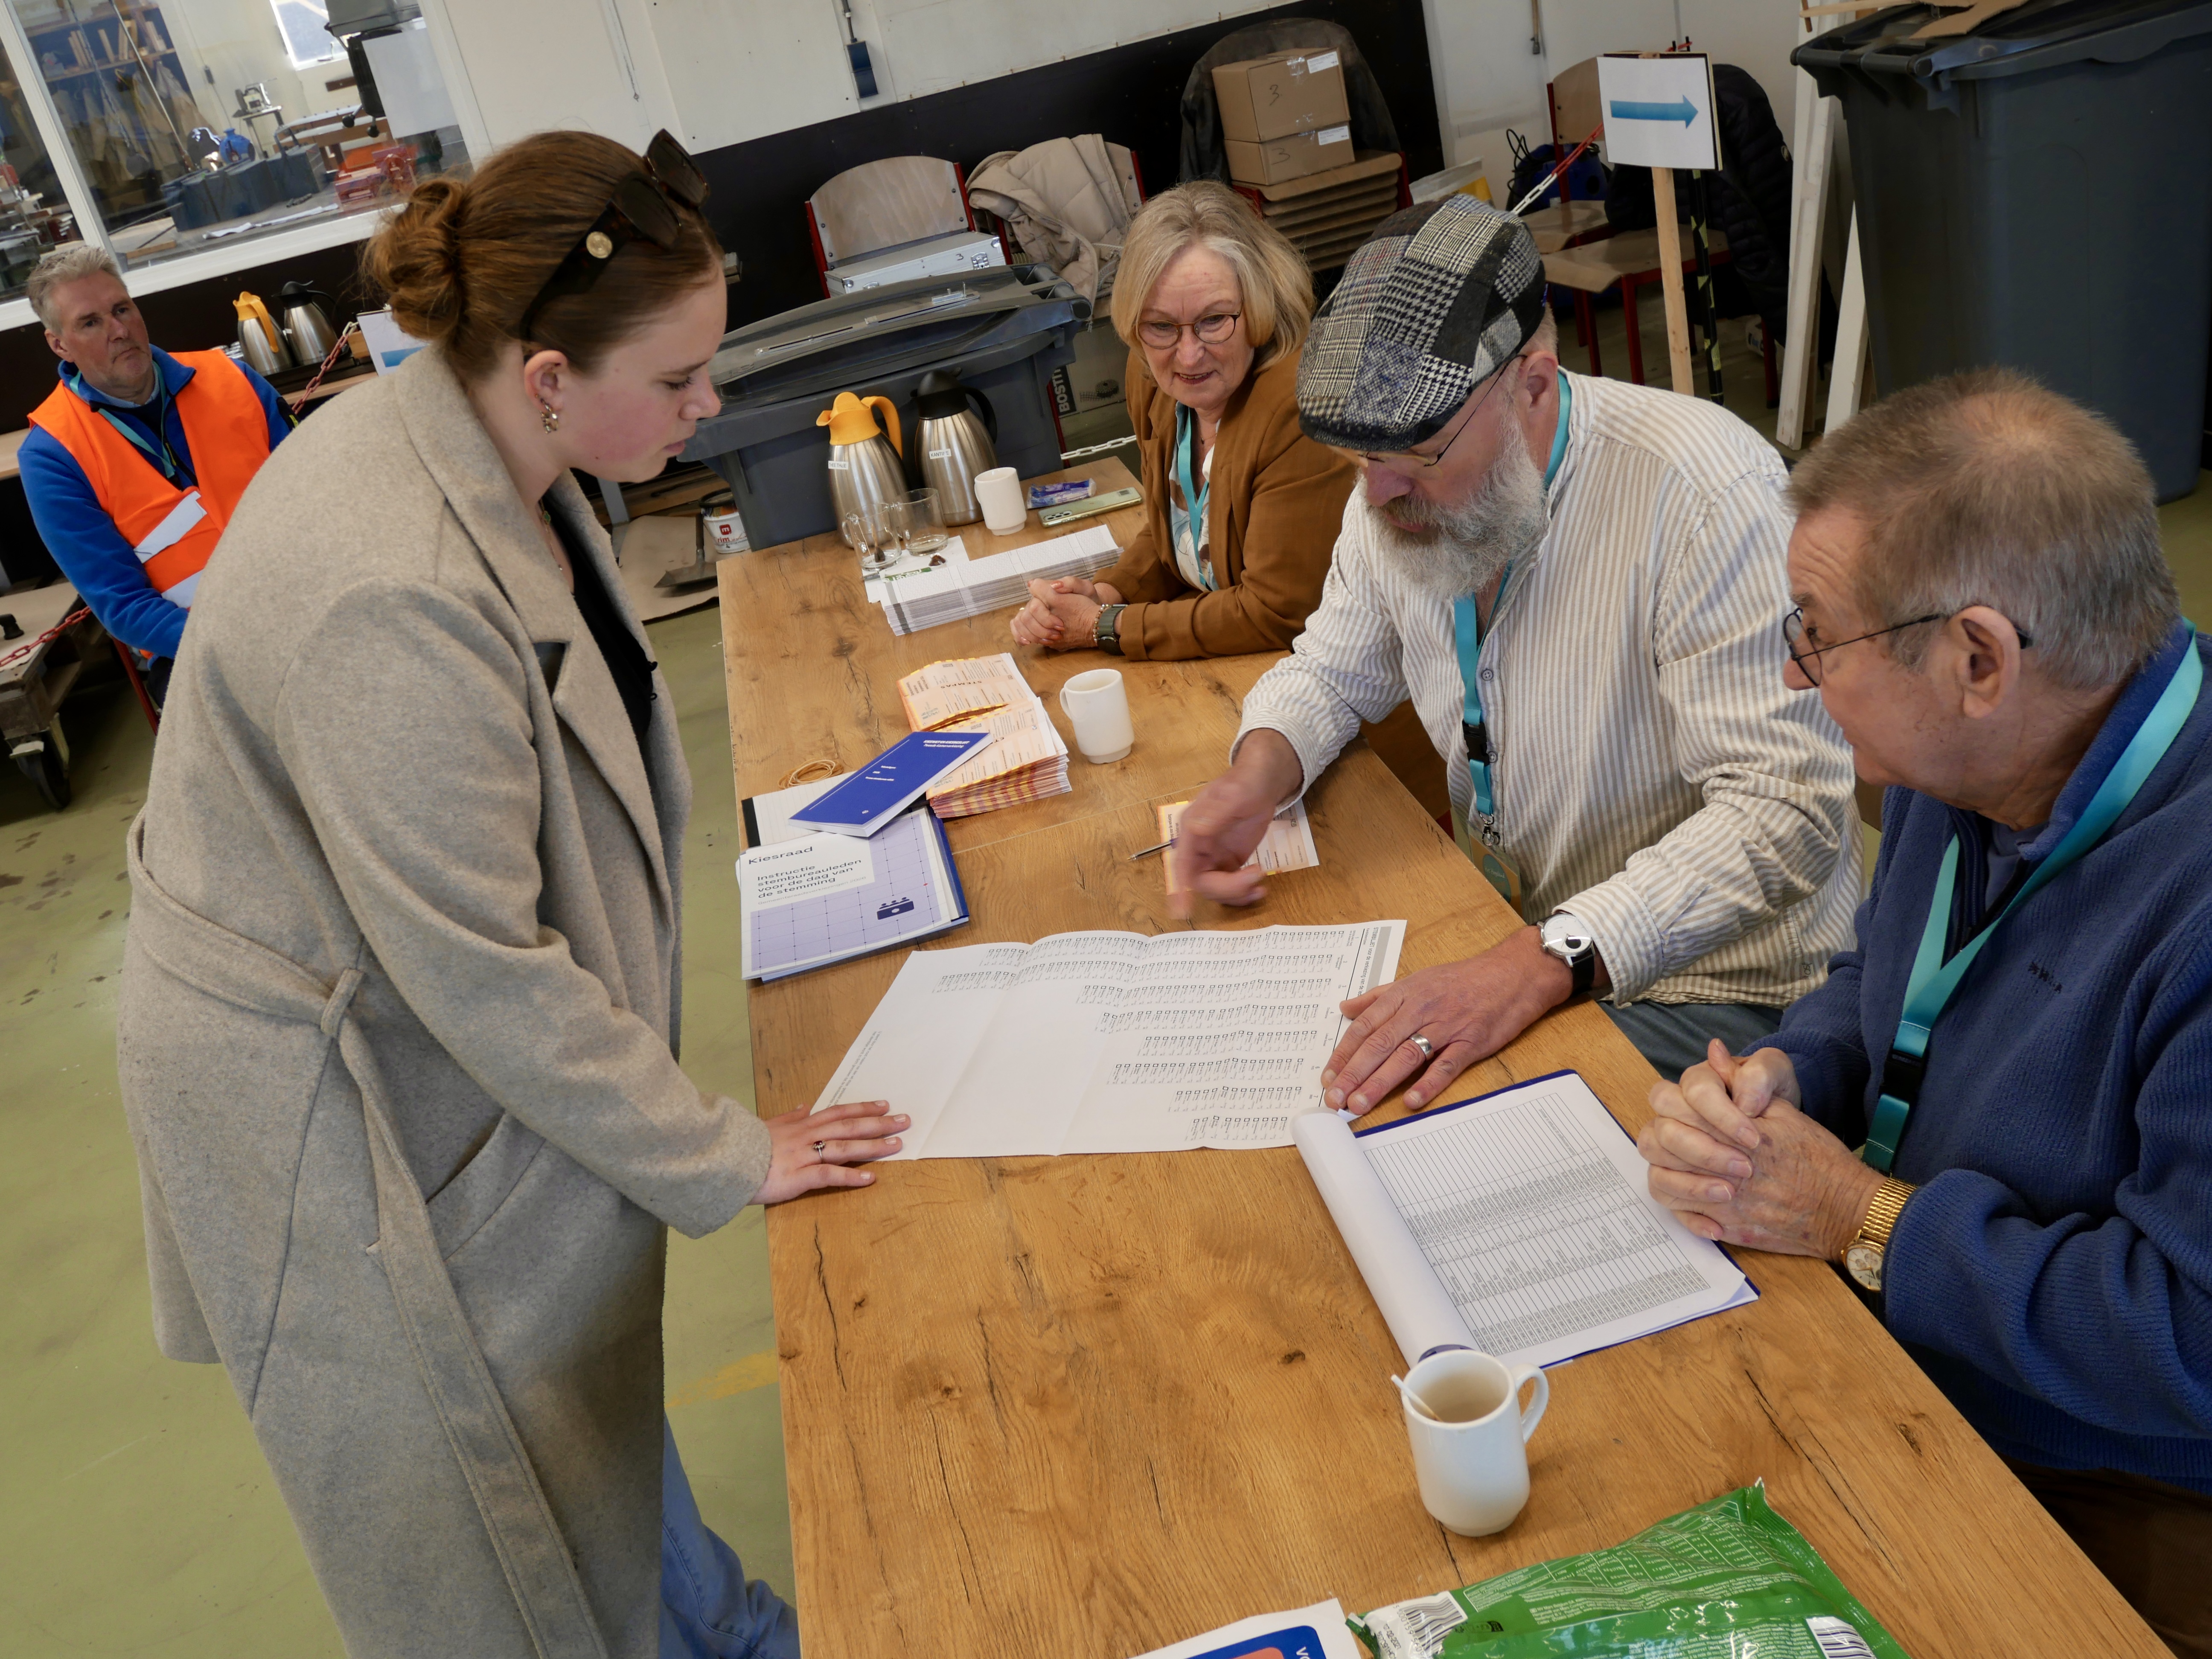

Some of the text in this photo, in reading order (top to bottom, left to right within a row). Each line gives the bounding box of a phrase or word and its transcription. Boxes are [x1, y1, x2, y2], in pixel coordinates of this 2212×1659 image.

[1271, 148, 1290, 165] 3
[940, 681, 982, 689] STEMPAS
[749, 847, 812, 864] Kiesraad
[758, 859, 861, 886] stembureauleden
[758, 866, 815, 881] Instructie
[758, 884, 784, 892] voor
[758, 882, 848, 905] Gemeenteraadsverkiezingen
[777, 878, 835, 894] stemming
[1368, 927, 1379, 947] STEMBILJET
[1360, 961, 1370, 977] verkiezing
[1396, 1610, 1415, 1635] 000159
